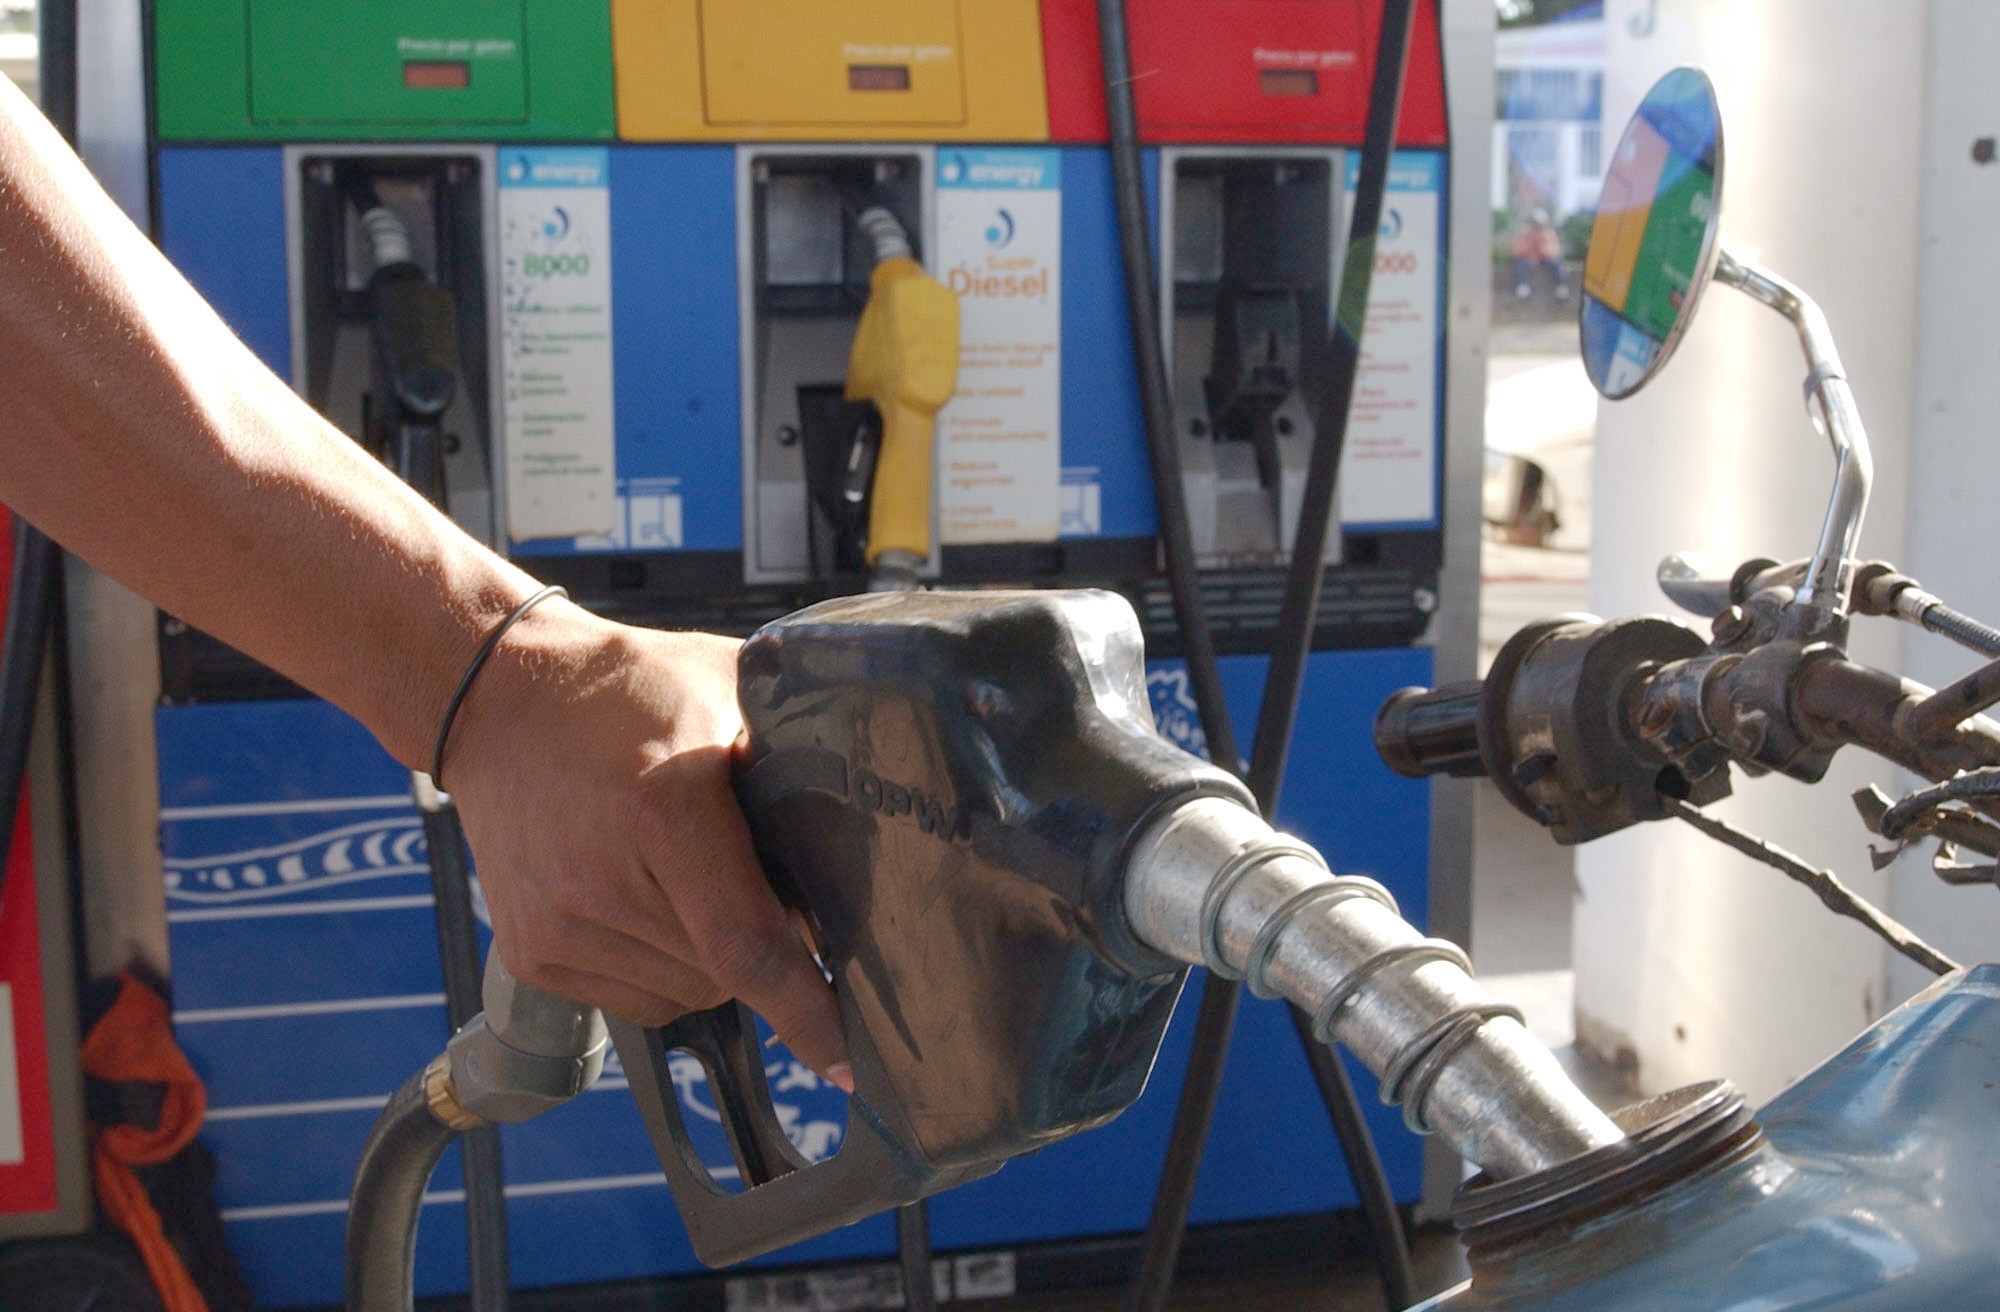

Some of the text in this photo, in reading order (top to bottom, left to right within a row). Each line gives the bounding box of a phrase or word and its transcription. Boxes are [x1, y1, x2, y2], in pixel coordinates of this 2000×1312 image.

[532, 165, 600, 184] energy
[969, 165, 1044, 187] energy
[1387, 171, 1429, 187] ergy
[985, 256, 1036, 270] Super
[1373, 254, 1417, 274] 000
[949, 268, 1048, 297] Diesel
